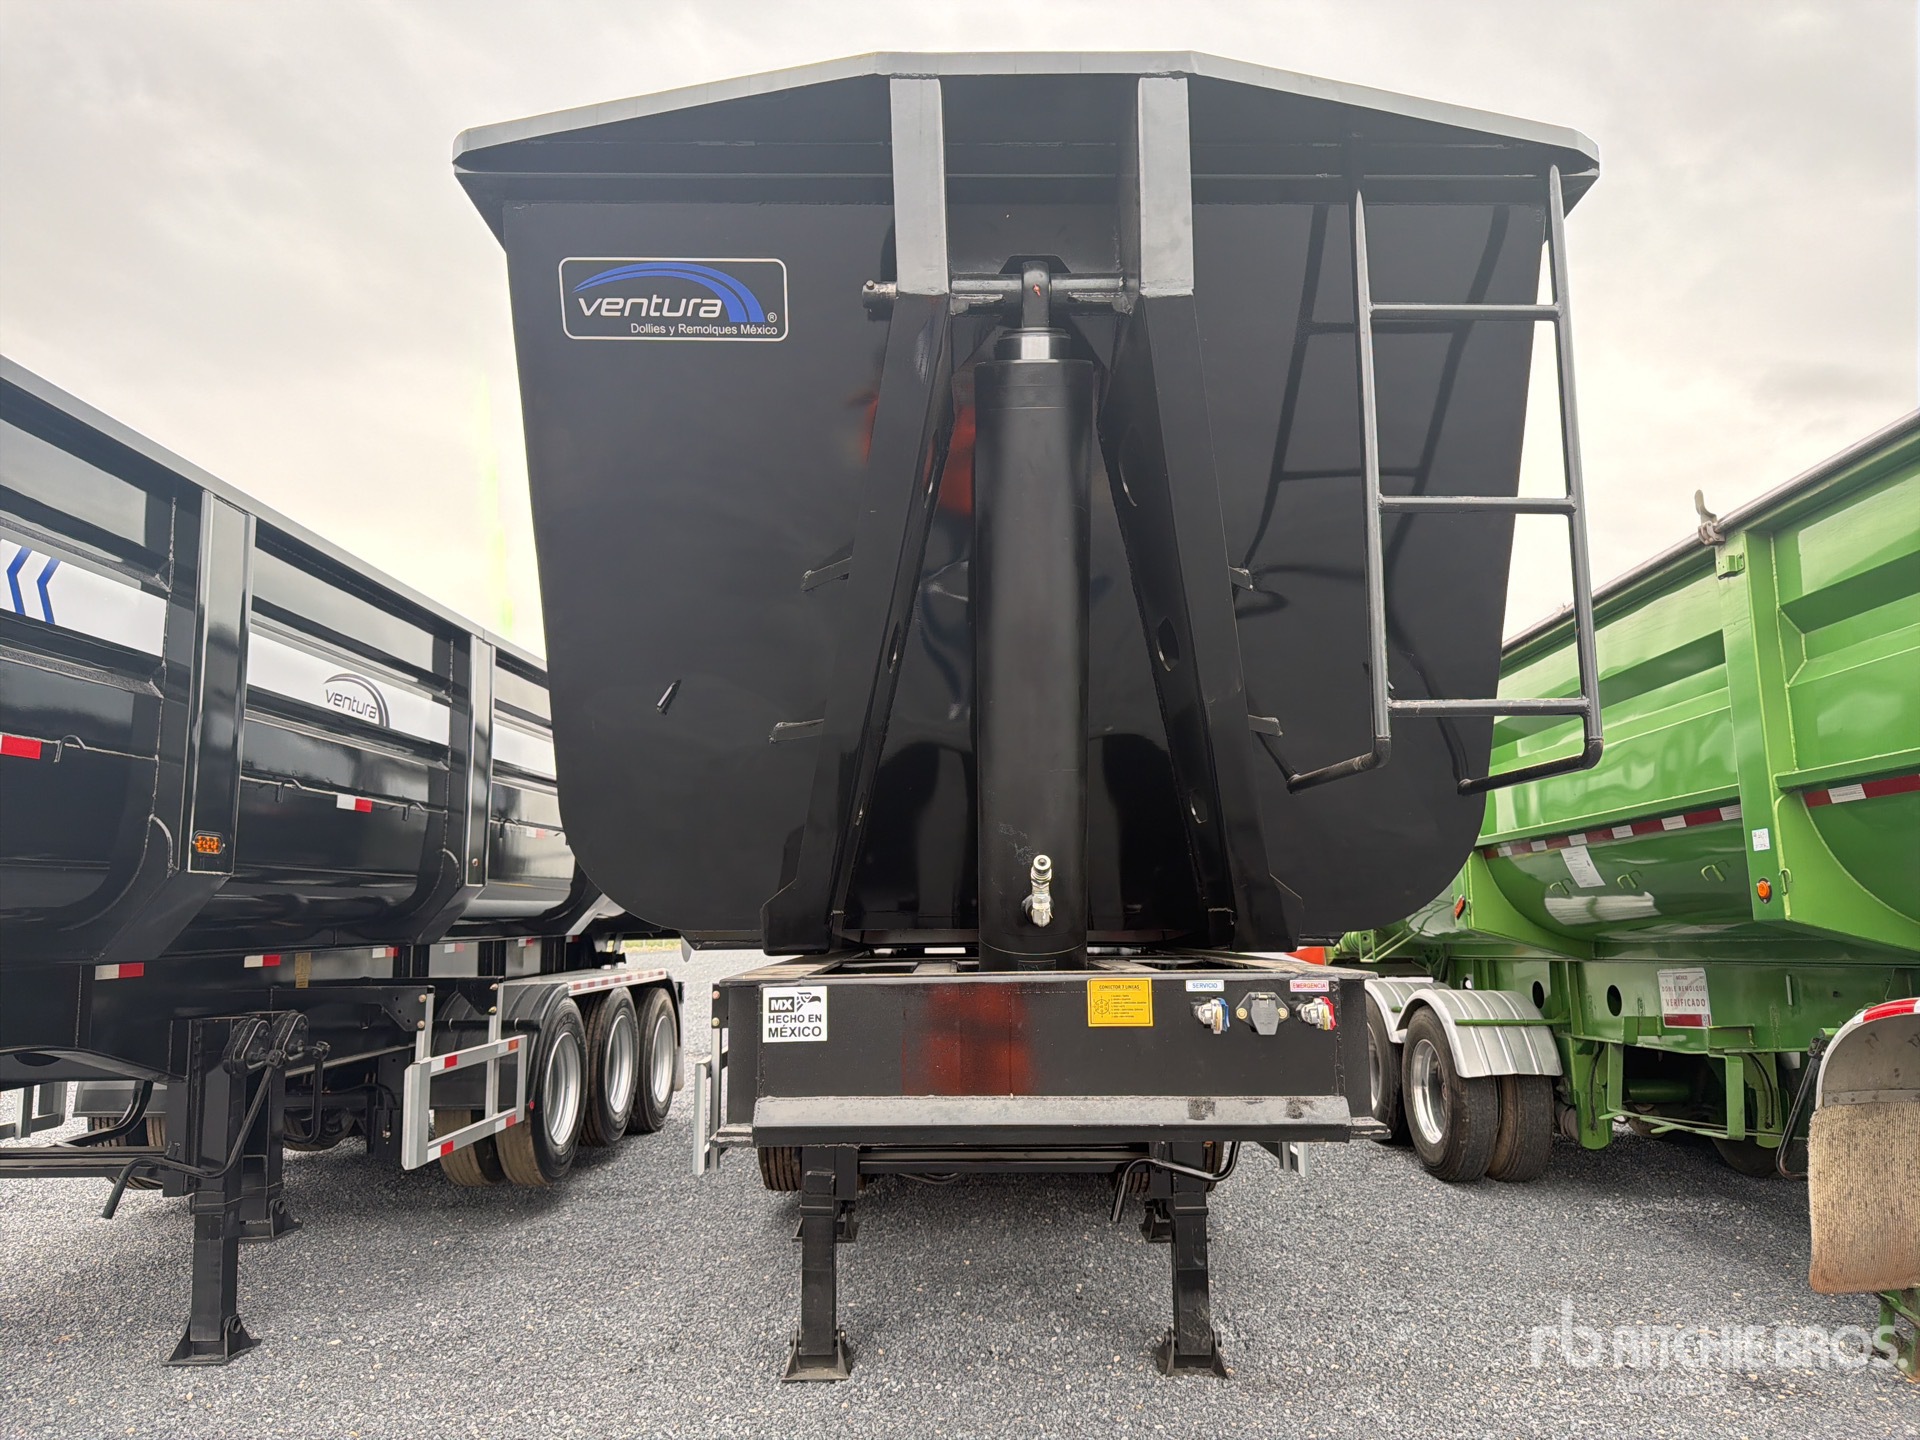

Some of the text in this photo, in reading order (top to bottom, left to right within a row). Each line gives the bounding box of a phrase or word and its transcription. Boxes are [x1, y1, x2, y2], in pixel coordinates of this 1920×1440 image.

[578, 294, 722, 318] ventura
[630, 322, 778, 336] Dollies y Remolques México
[325, 689, 377, 719] ventura
[770, 999, 793, 1011] MX
[1665, 998, 1706, 1007] VERIFICADO
[768, 1014, 822, 1024] HECHO EN
[768, 1024, 822, 1038] MÉXICO
